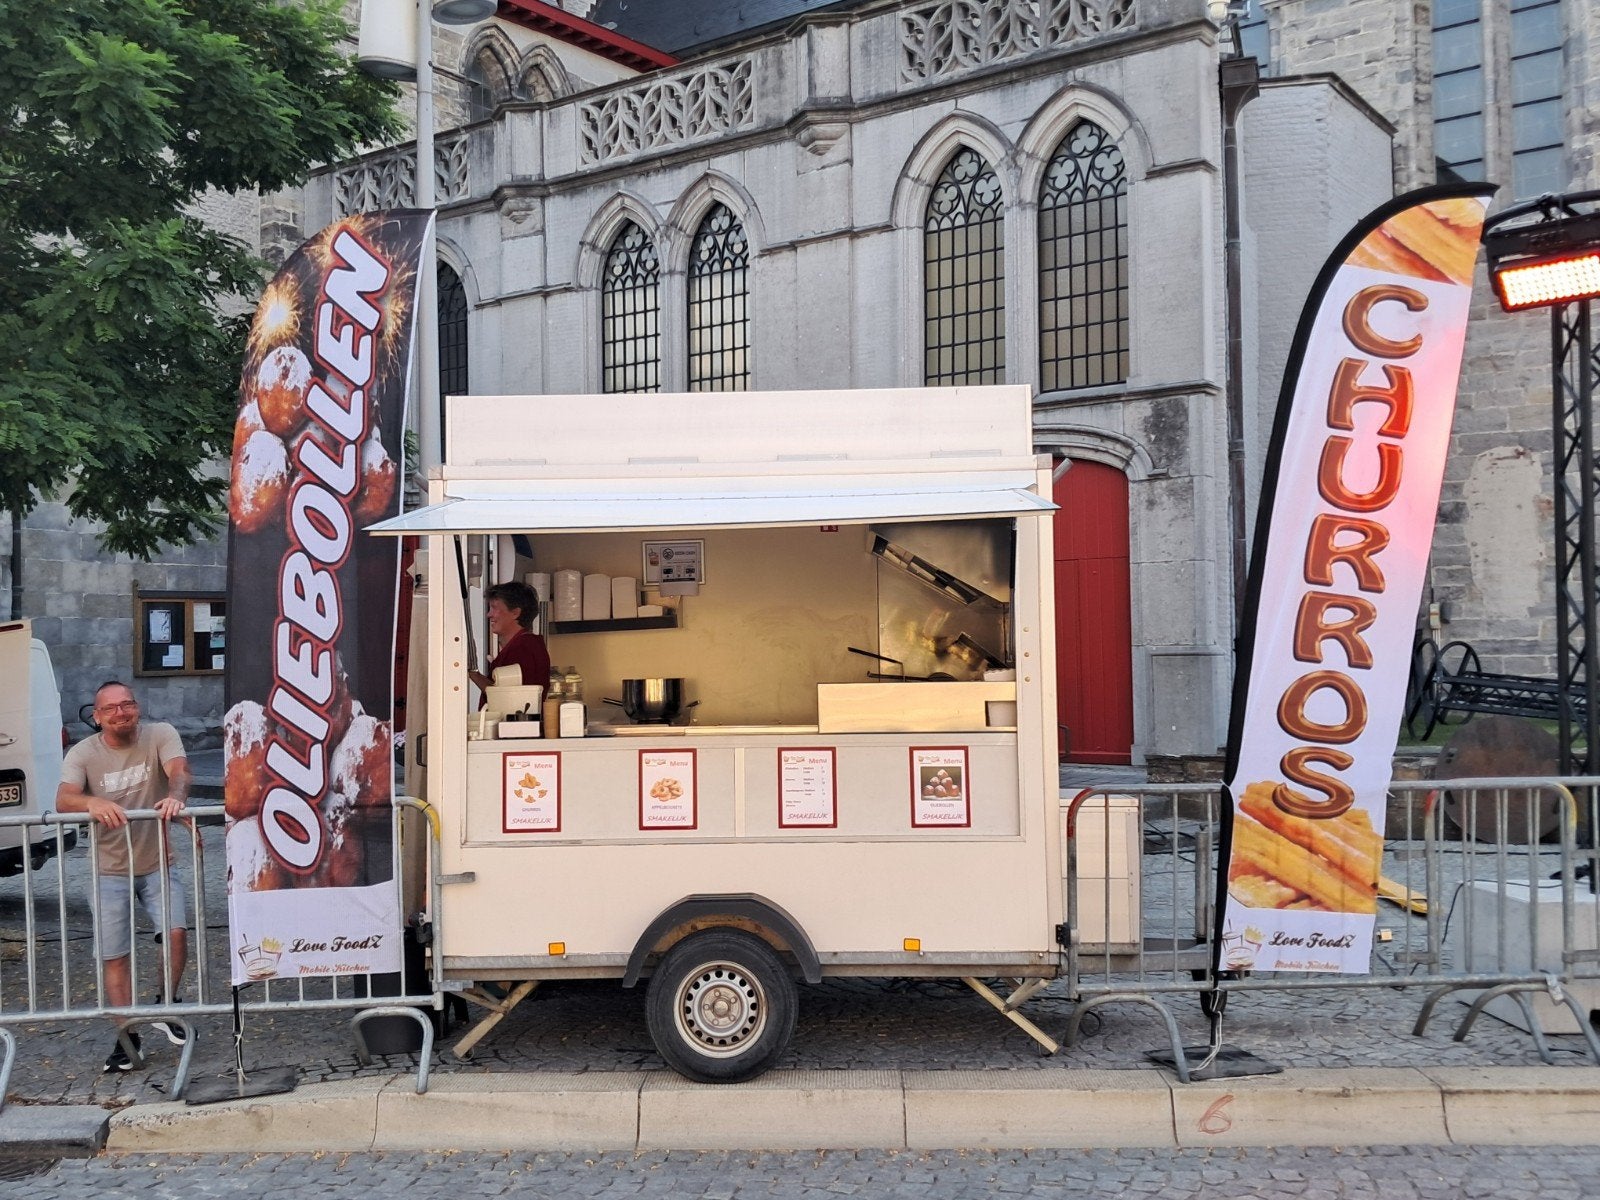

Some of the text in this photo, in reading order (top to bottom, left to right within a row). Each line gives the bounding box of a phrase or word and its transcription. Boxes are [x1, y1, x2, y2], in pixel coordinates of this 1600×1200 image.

[259, 226, 391, 872] OLIEBOLLEN
[1272, 283, 1429, 819] CHURROS
[289, 934, 384, 953] Love FoodZ
[1268, 931, 1356, 948] Love FoodZ
[299, 963, 371, 974] Mobile Kitchen
[1274, 960, 1303, 969] Mobile
[1198, 1094, 1234, 1134] 6
